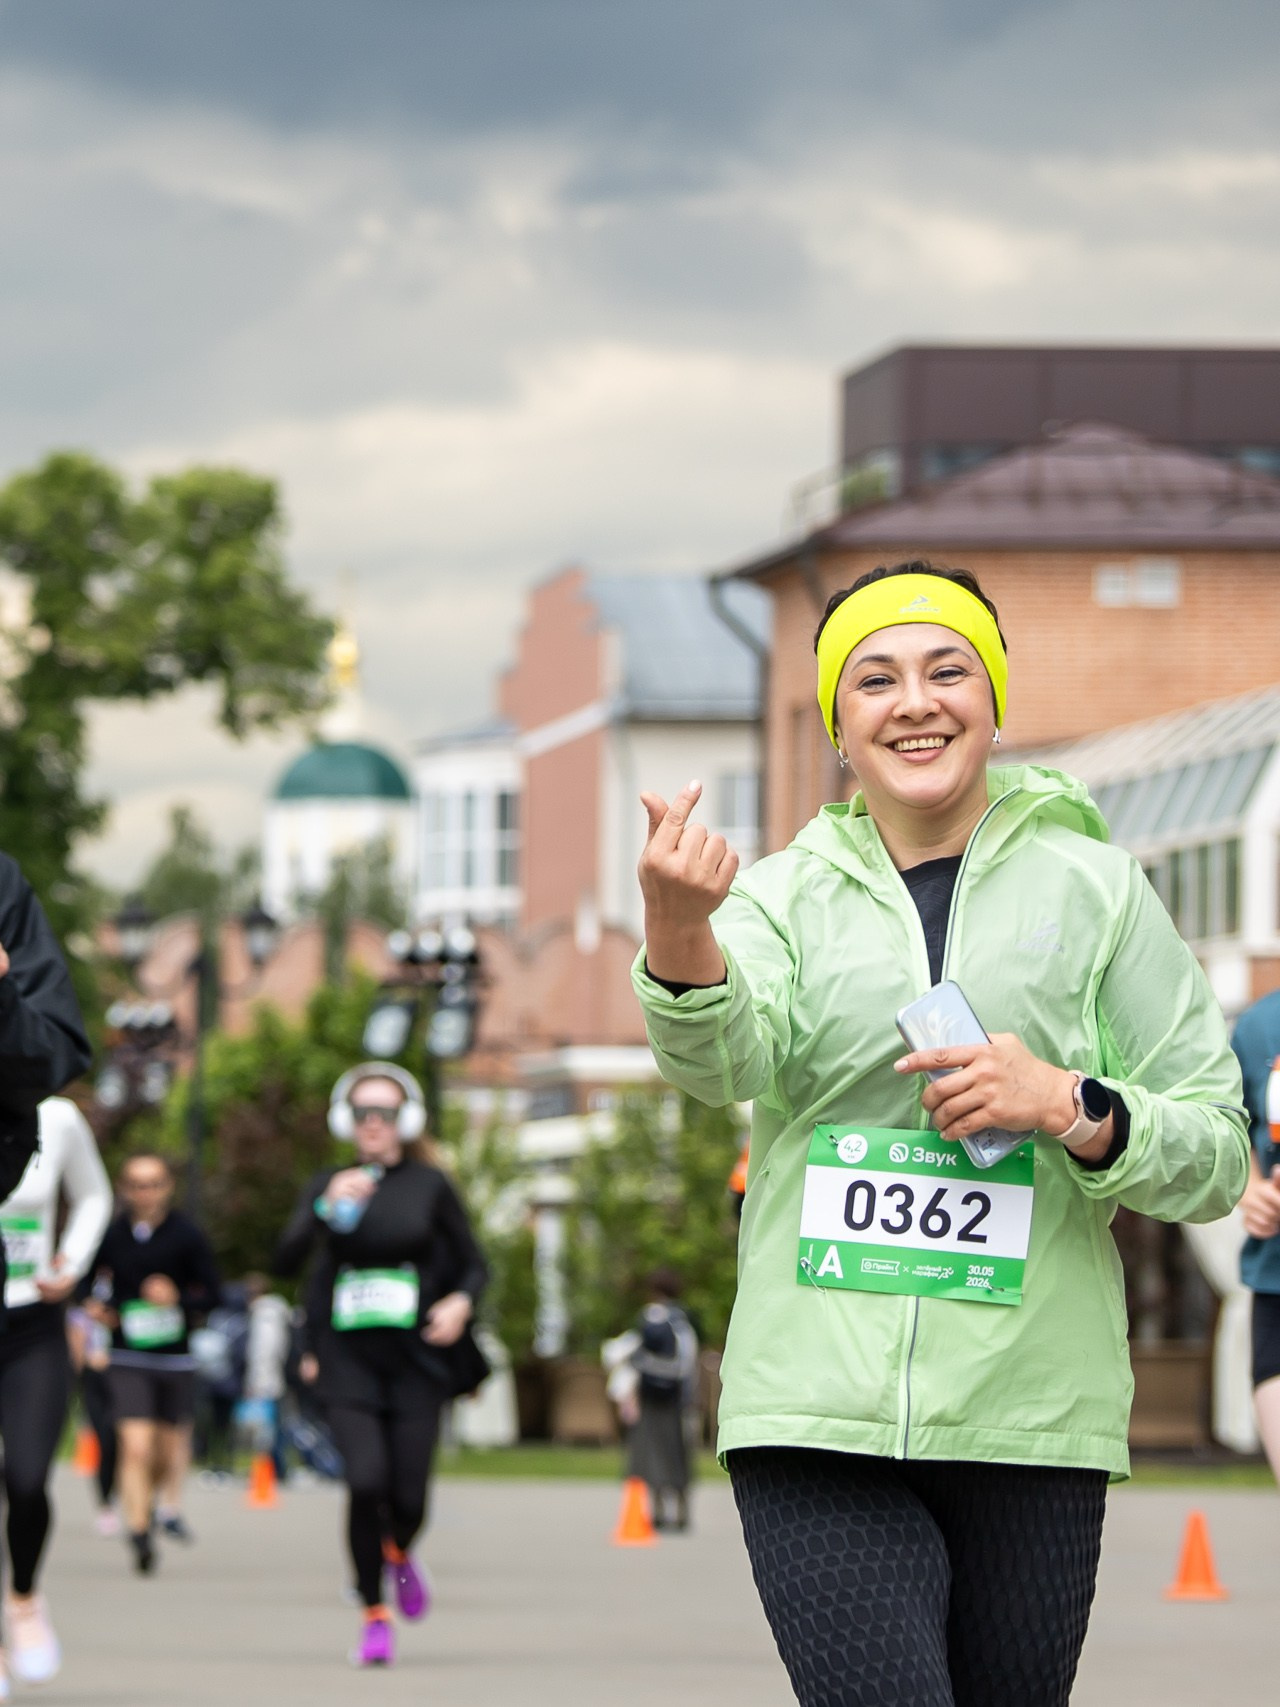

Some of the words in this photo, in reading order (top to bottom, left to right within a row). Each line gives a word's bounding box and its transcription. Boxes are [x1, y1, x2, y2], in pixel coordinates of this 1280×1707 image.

[843, 1140, 862, 1153] 4,2
[912, 1147, 957, 1167] Звук
[844, 1180, 991, 1244] 0362
[967, 1265, 995, 1277] 30.05
[965, 1276, 990, 1288] 2026
